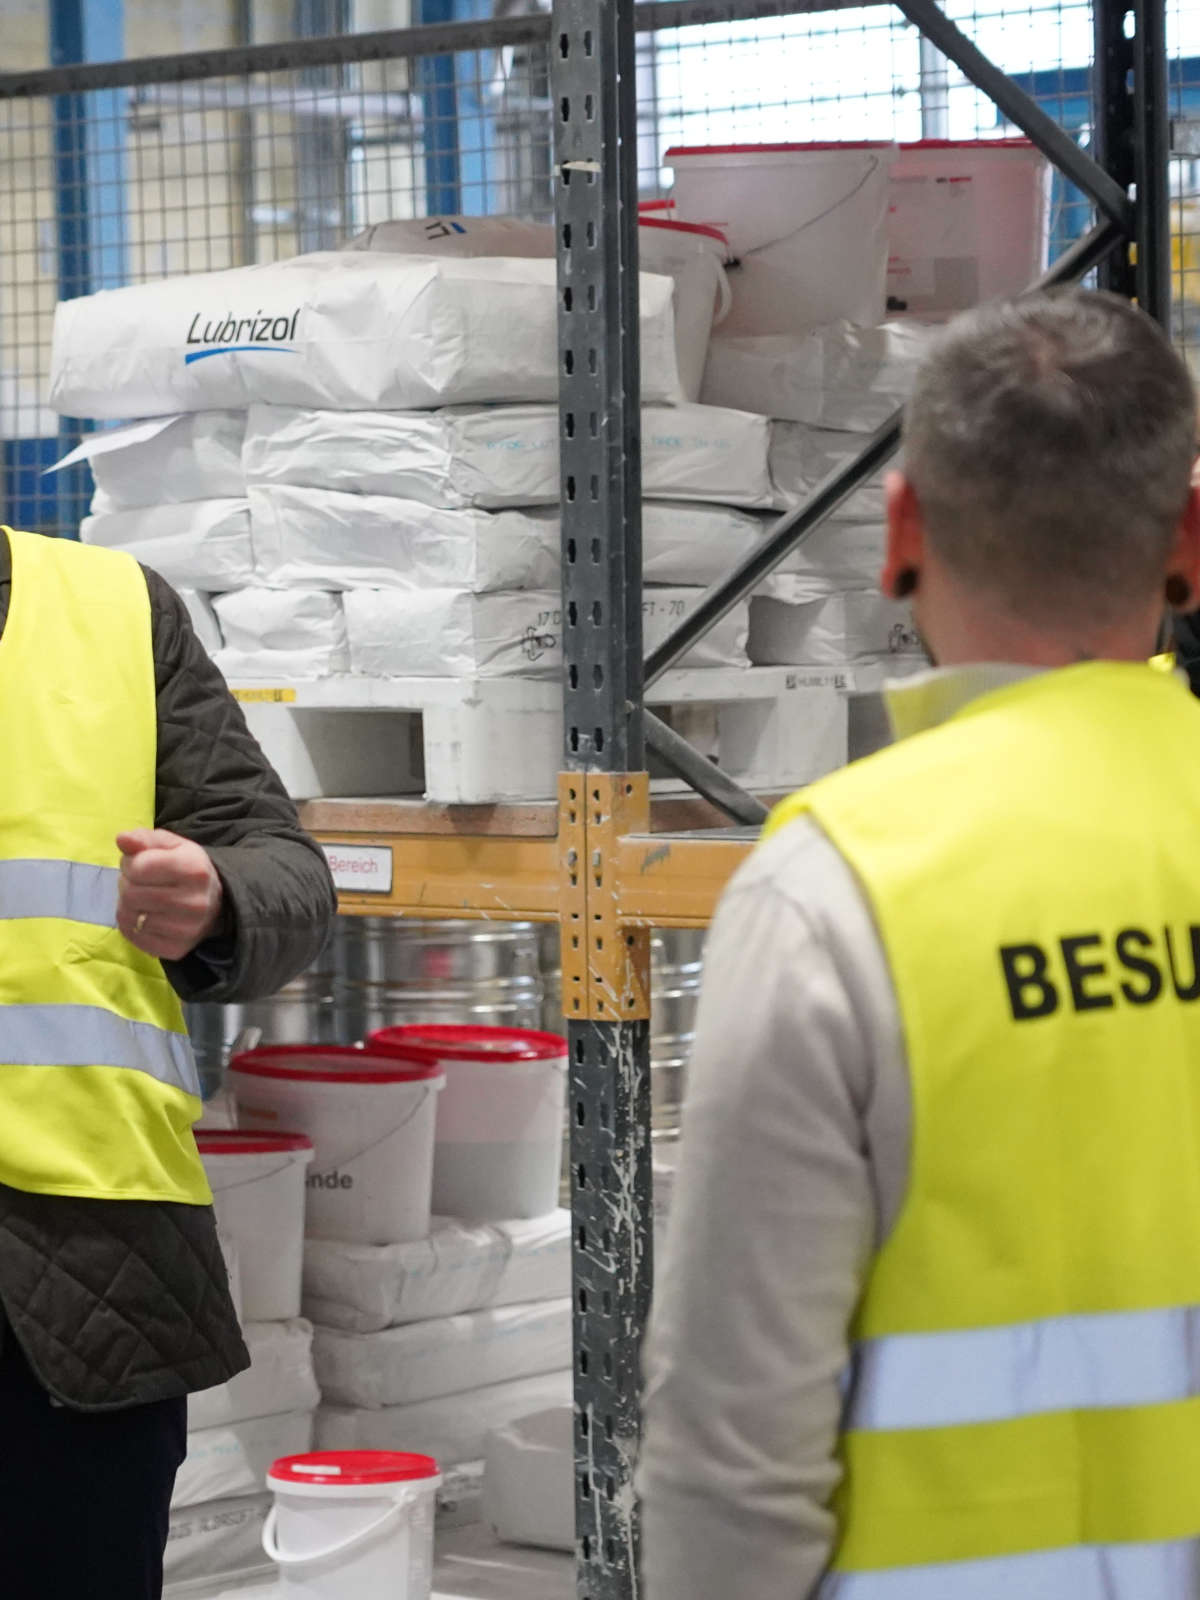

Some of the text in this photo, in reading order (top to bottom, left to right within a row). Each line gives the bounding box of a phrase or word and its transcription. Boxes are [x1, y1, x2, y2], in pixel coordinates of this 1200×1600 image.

[186, 308, 300, 344] Lubrizol
[328, 855, 379, 873] Bereich
[998, 922, 1200, 1022] BESU
